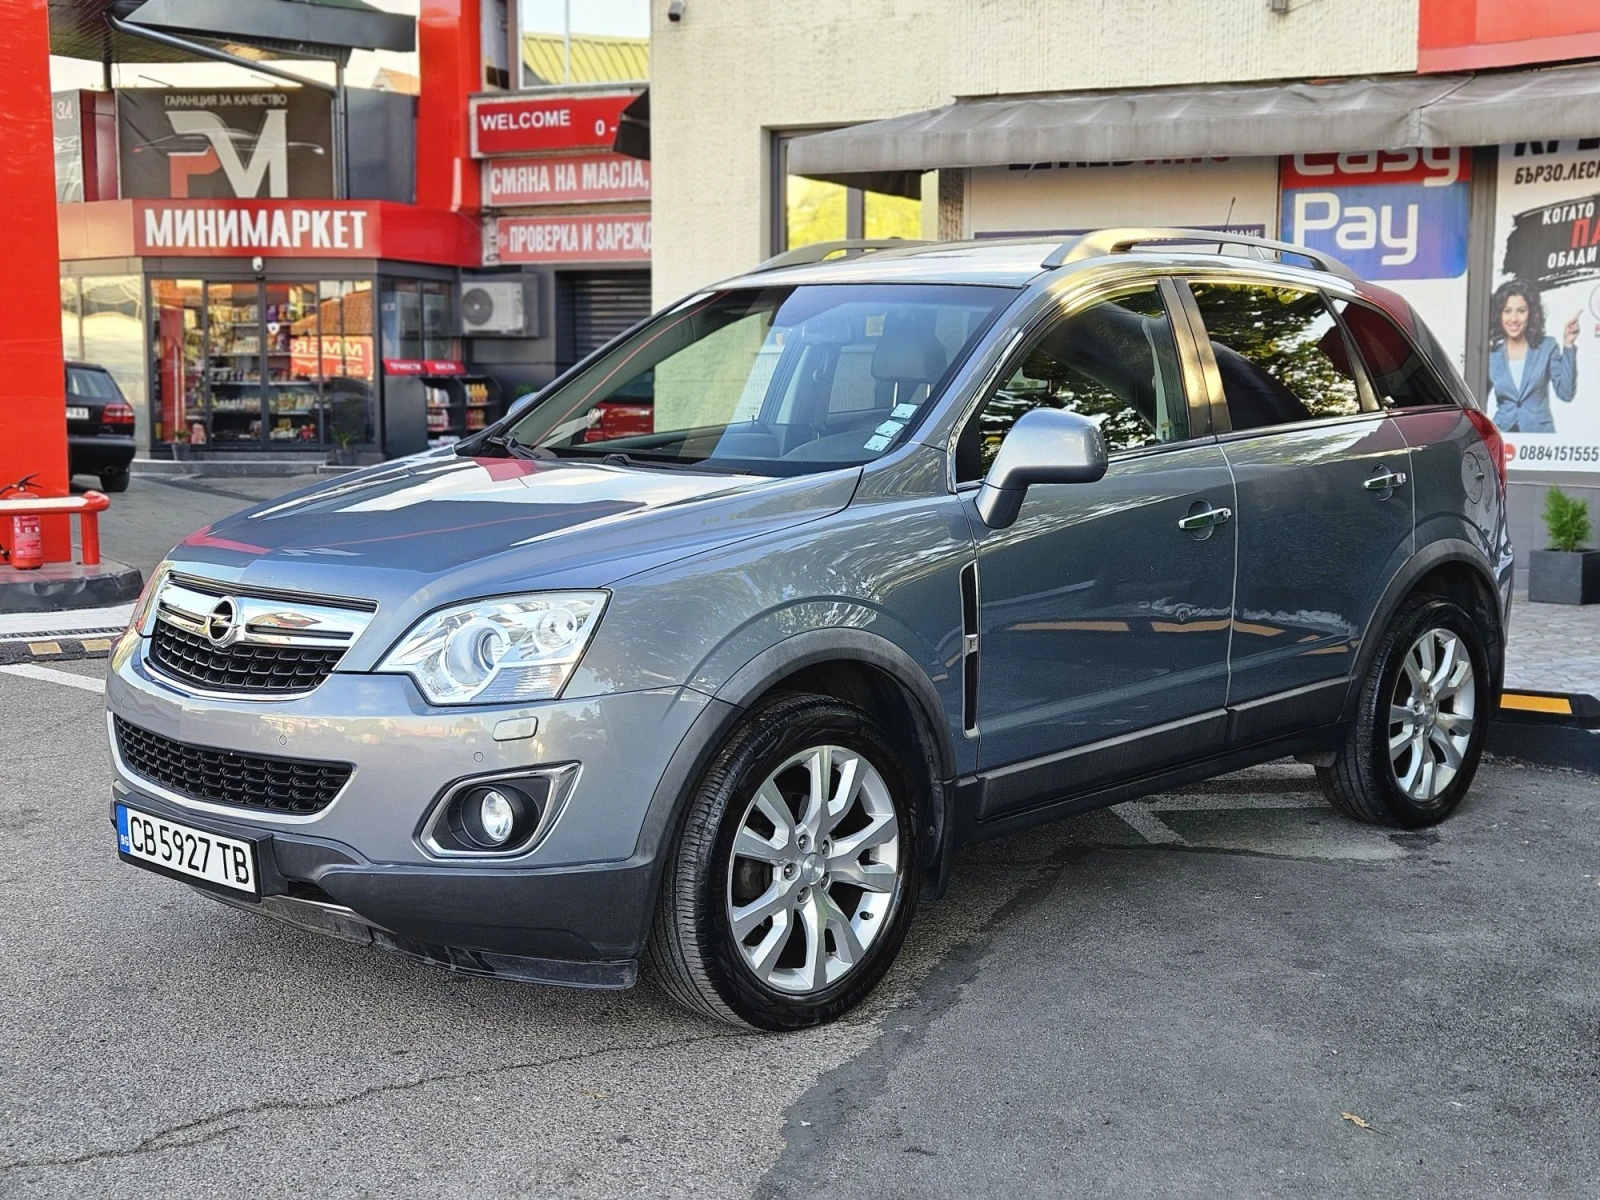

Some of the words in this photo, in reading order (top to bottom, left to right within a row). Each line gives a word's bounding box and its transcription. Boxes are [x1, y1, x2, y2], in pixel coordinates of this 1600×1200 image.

[164, 94, 217, 107] ГАРАНЦИЯ
[218, 94, 232, 106] ЗА
[233, 93, 287, 106] КАЧЕСТВО
[480, 109, 571, 131] WELCOME
[491, 166, 549, 194] СМЯНА
[555, 163, 576, 191] НА
[582, 159, 649, 192] МАСЛА,
[1542, 202, 1595, 225] КОГАТО
[144, 208, 367, 249] МИНИМАРКЕТ
[509, 224, 578, 253] ПРОВЕРКА
[582, 223, 593, 251] И
[1293, 192, 1419, 266] Pay
[1547, 246, 1598, 269] ОБАДИ
[1519, 445, 1600, 462] 0884151555
[121, 834, 130, 846] BG
[160, 825, 211, 872] 5927
